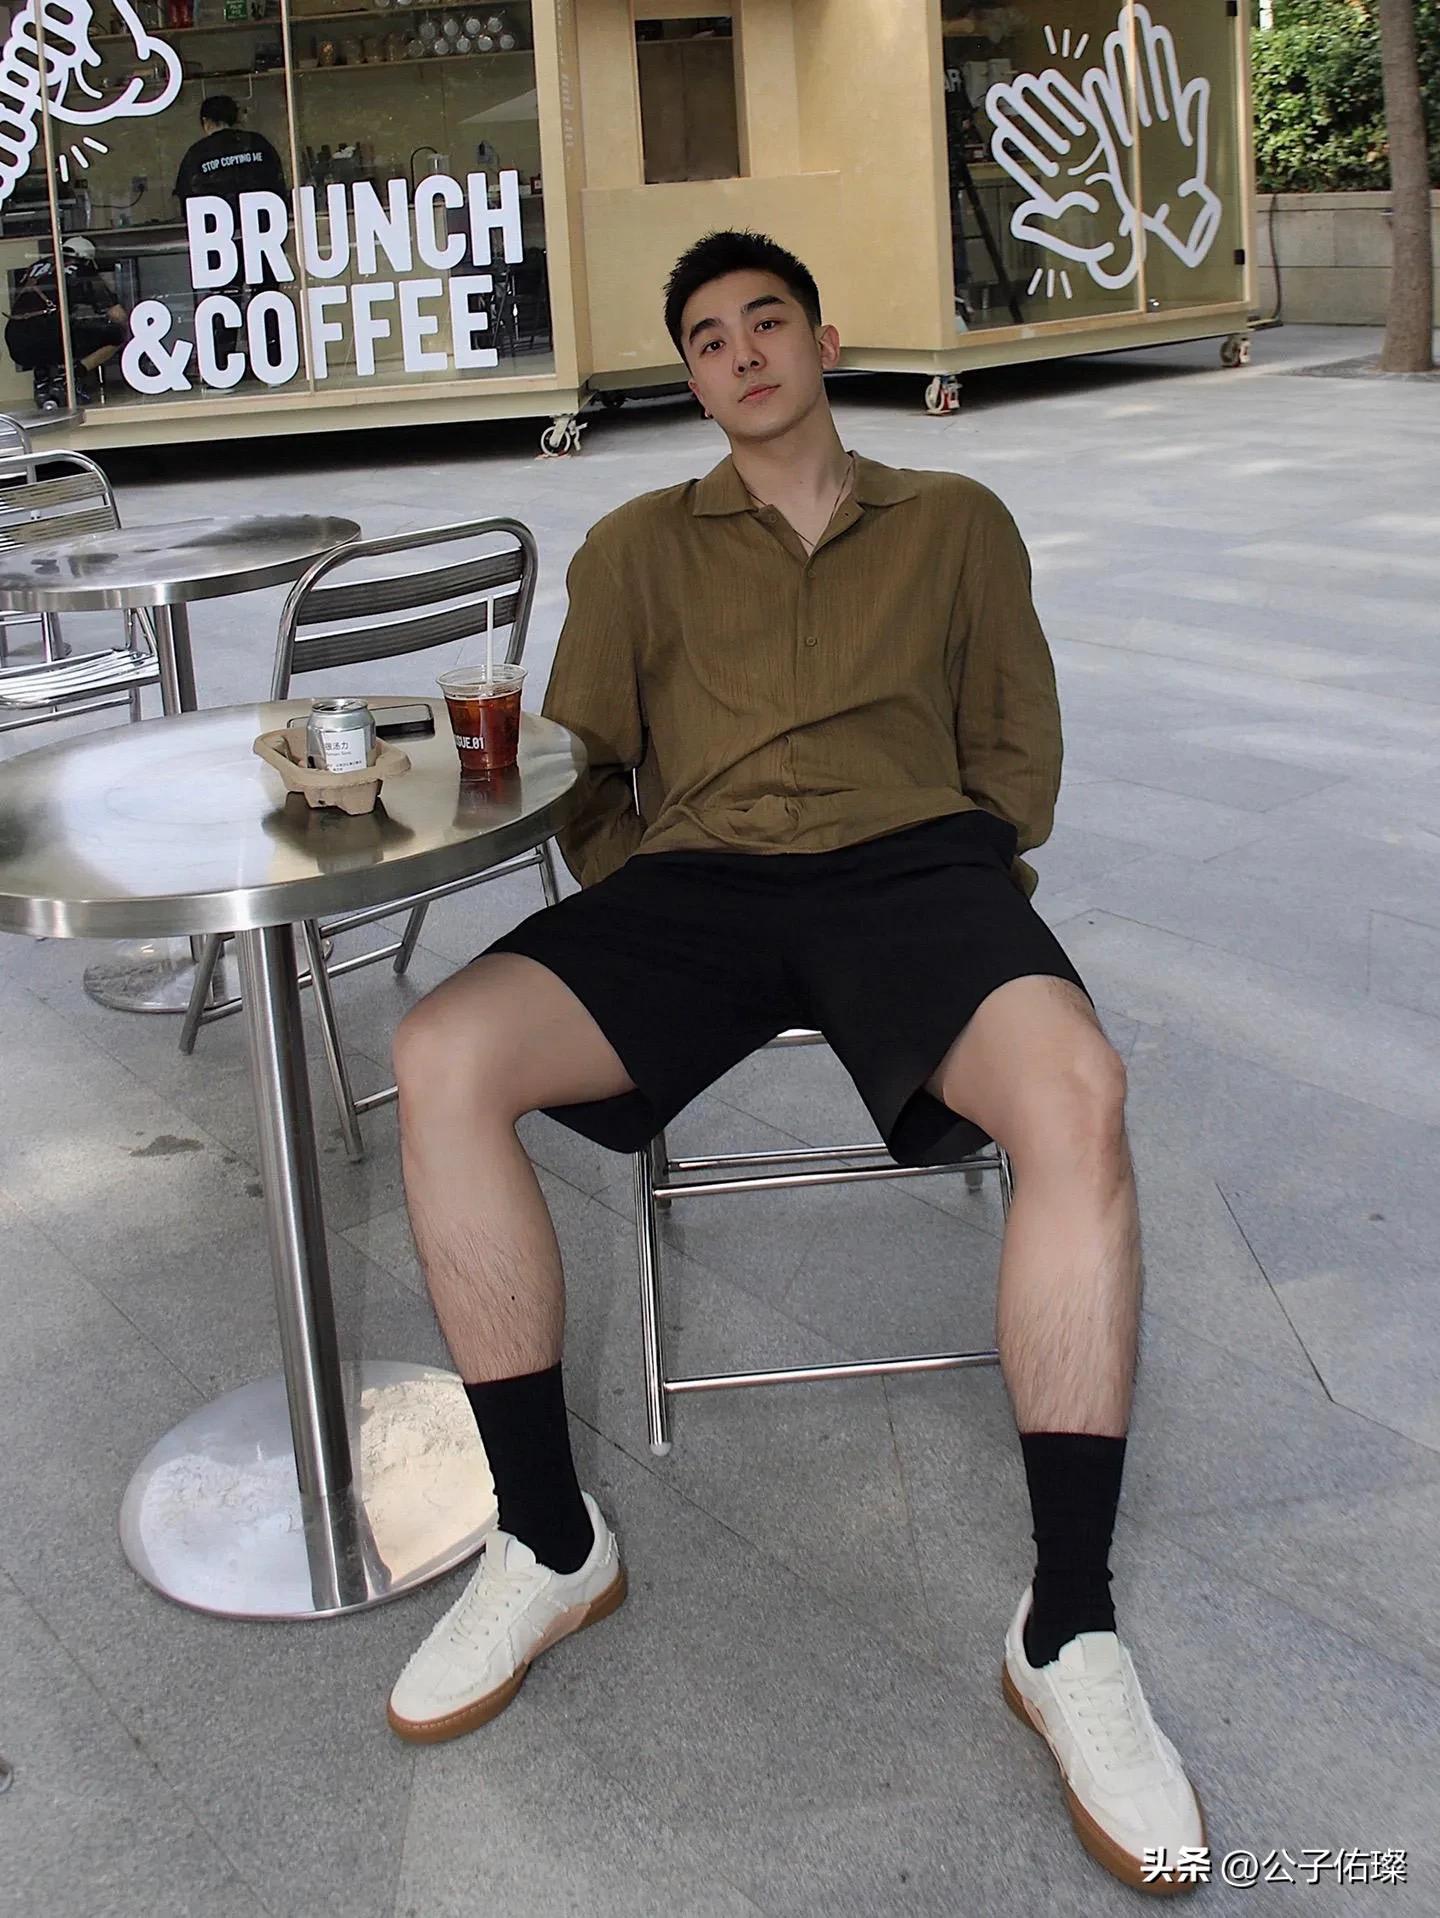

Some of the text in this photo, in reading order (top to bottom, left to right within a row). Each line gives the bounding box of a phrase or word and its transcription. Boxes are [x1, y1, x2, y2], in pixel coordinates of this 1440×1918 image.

[201, 159, 220, 173] STOP
[252, 151, 264, 162] ME
[185, 169, 524, 290] BRUNCH
[120, 274, 499, 396] &COFFEE
